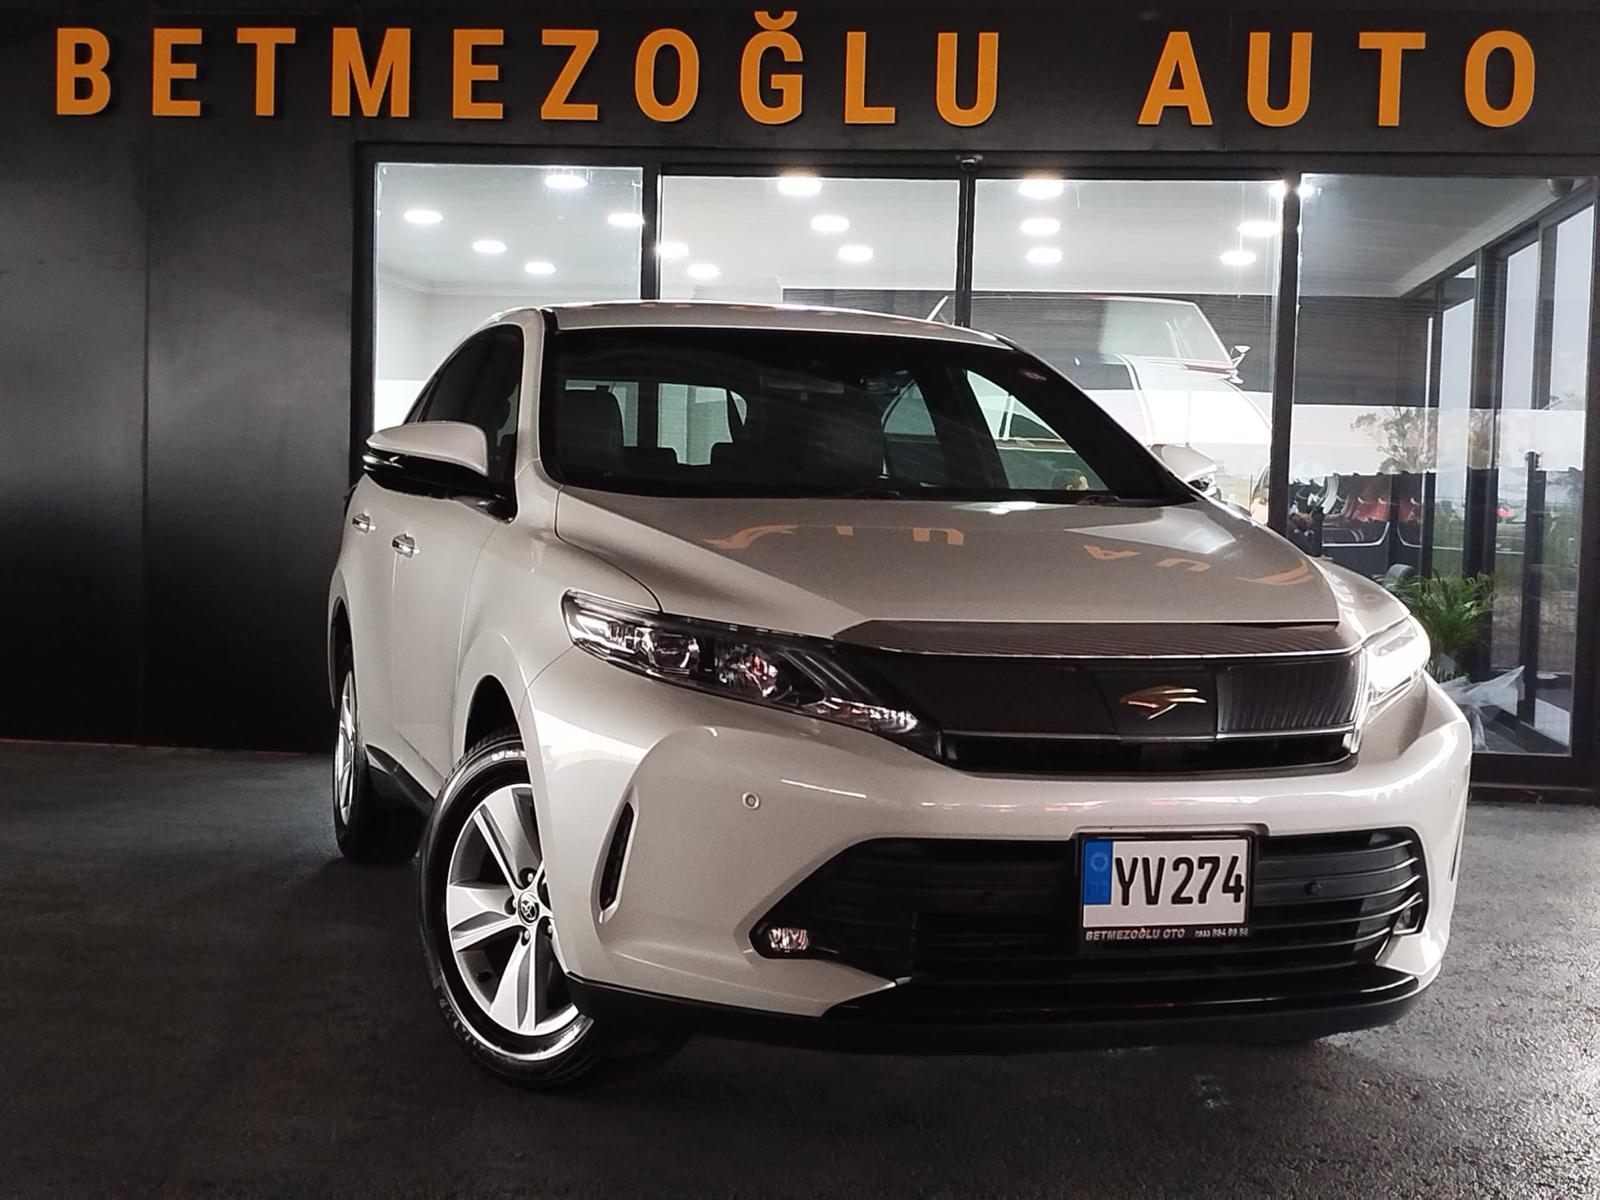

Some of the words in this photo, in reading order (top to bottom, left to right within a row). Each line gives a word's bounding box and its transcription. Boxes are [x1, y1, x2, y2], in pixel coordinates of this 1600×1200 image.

[56, 11, 999, 126] BETMEZOĞLU
[1137, 30, 1534, 127] AUTO
[1163, 928, 1186, 939] OTO
